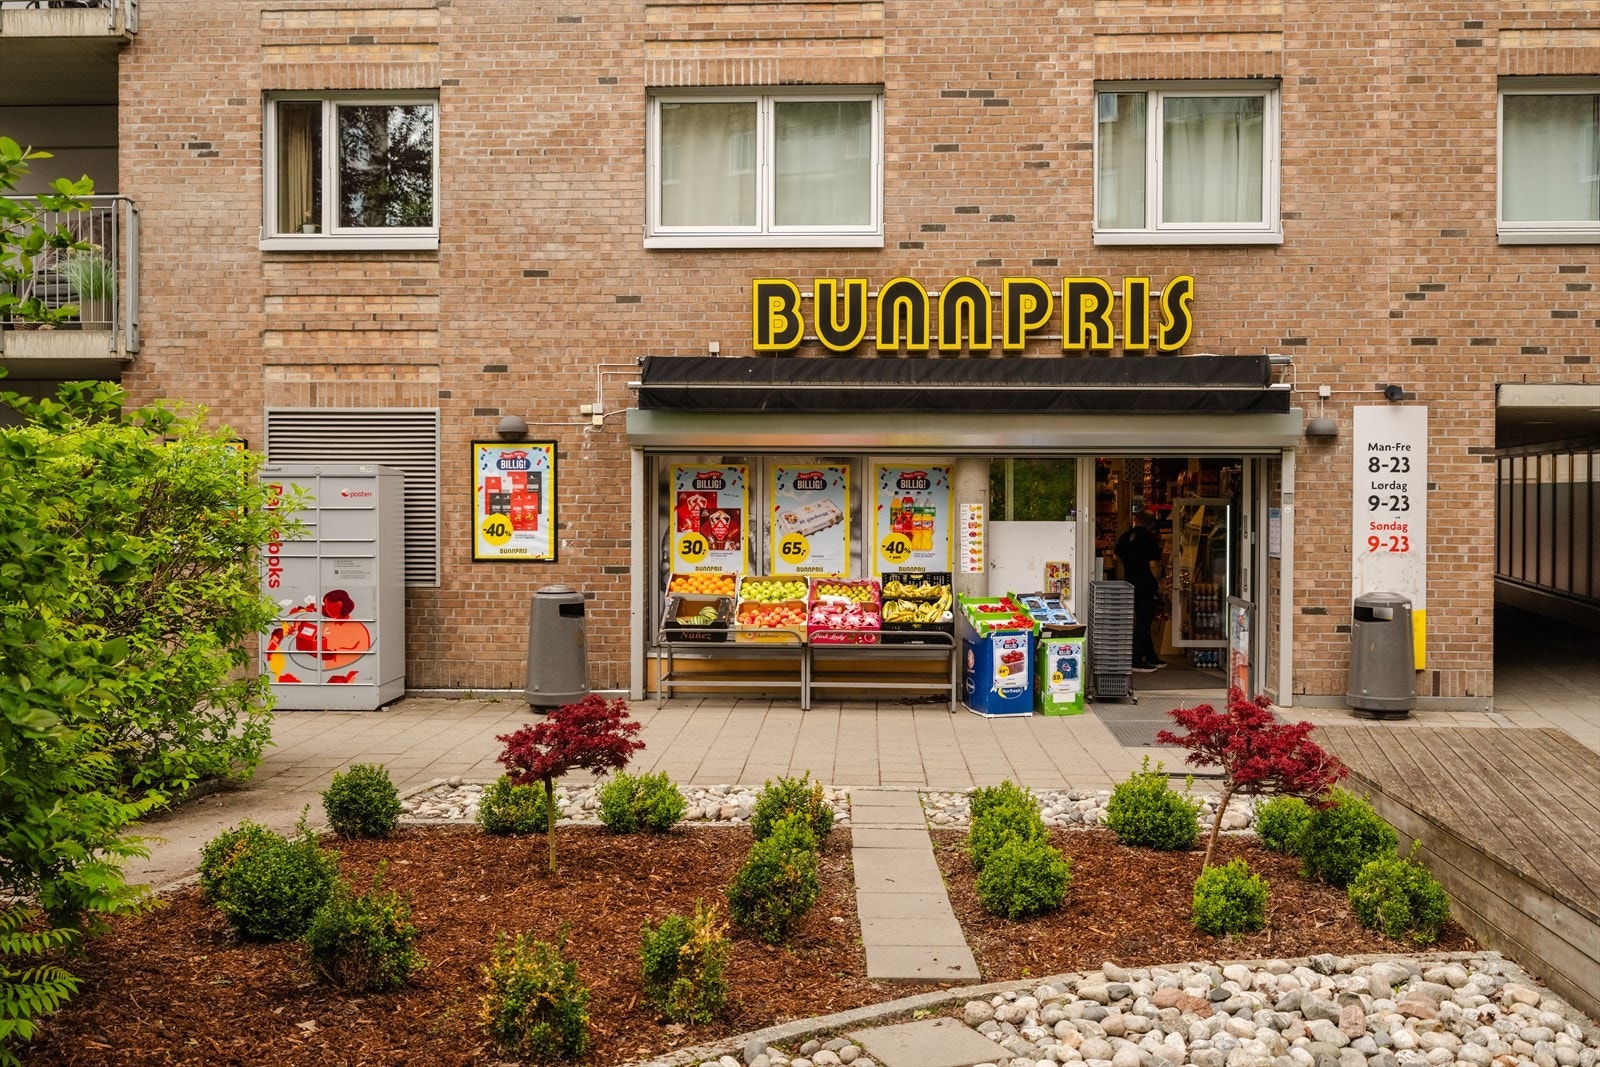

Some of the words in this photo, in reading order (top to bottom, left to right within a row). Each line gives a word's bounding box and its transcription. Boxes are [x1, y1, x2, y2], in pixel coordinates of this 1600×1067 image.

[752, 275, 1195, 352] BUNNPRIS
[1368, 443, 1411, 451] Man-Fre
[501, 459, 527, 469] BILLIG!
[1368, 457, 1410, 473] 8-23
[696, 479, 722, 489] BILLIG!
[797, 479, 823, 489] BILLIG!
[900, 479, 926, 489] BILLIG!
[1371, 481, 1408, 492] Lørdag
[350, 490, 372, 498] posten
[1368, 495, 1410, 511] 9-23
[483, 523, 512, 537] -40%
[1369, 521, 1408, 533] Søndag
[882, 541, 911, 554] -40%
[1367, 535, 1410, 552] 9-23
